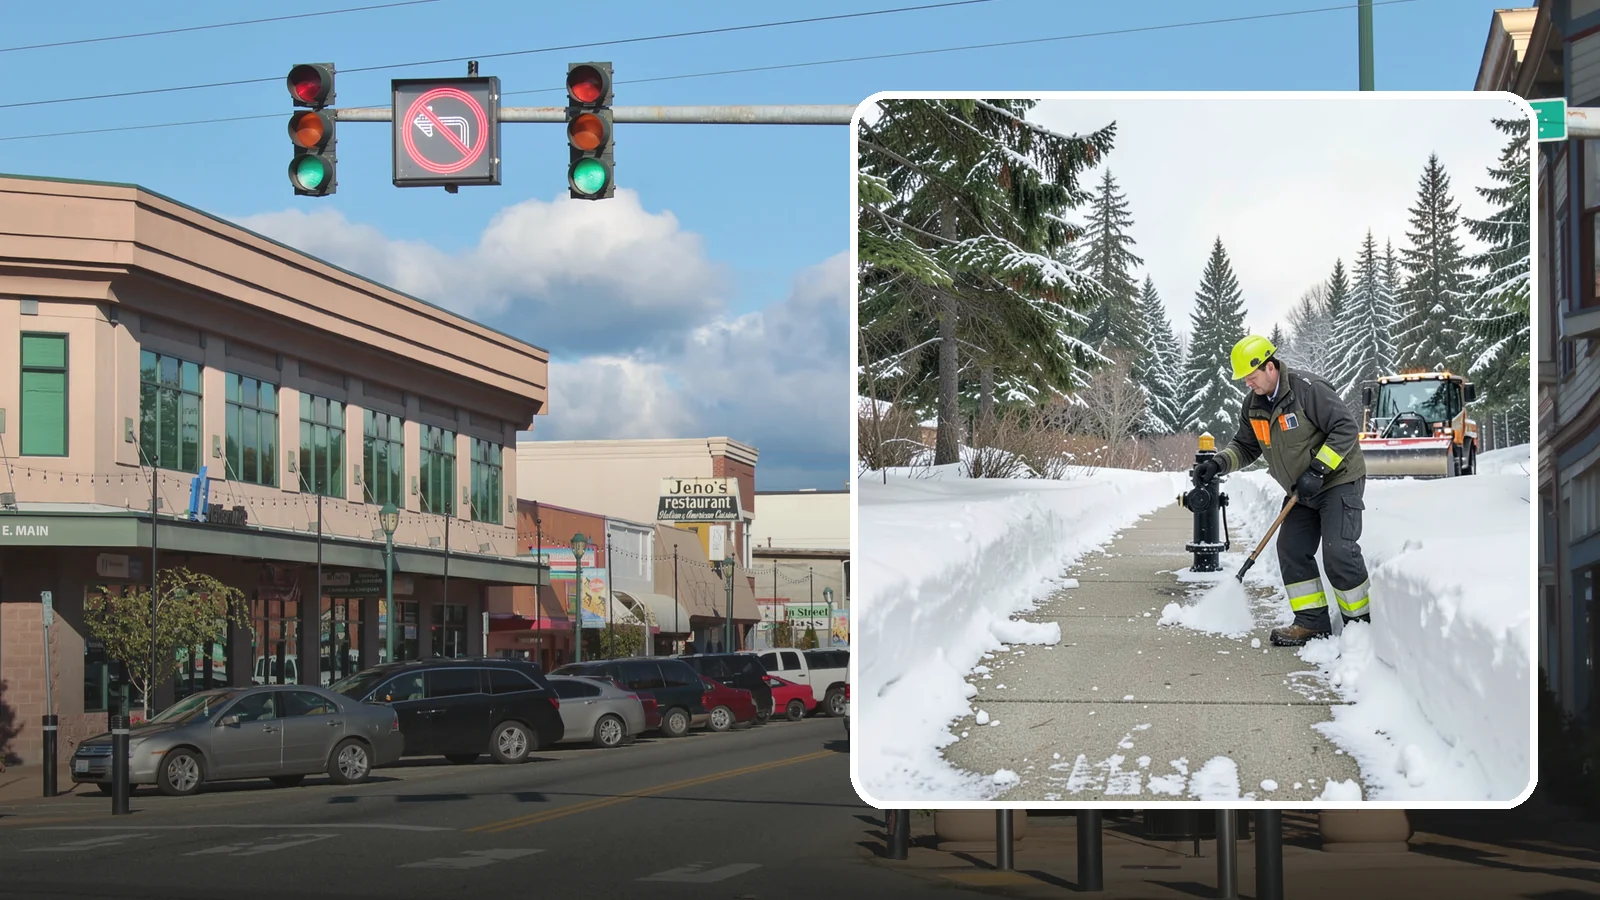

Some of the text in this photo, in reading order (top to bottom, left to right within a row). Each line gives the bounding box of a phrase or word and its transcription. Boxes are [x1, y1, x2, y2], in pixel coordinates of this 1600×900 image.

[669, 480, 727, 494] Jeno's
[665, 496, 731, 509] restaurant
[659, 510, 682, 519] Italian
[686, 509, 715, 519] American
[715, 509, 737, 519] Cuisine
[2, 525, 49, 536] E. MAIN
[786, 607, 828, 616] in Street
[791, 619, 824, 627] lass
